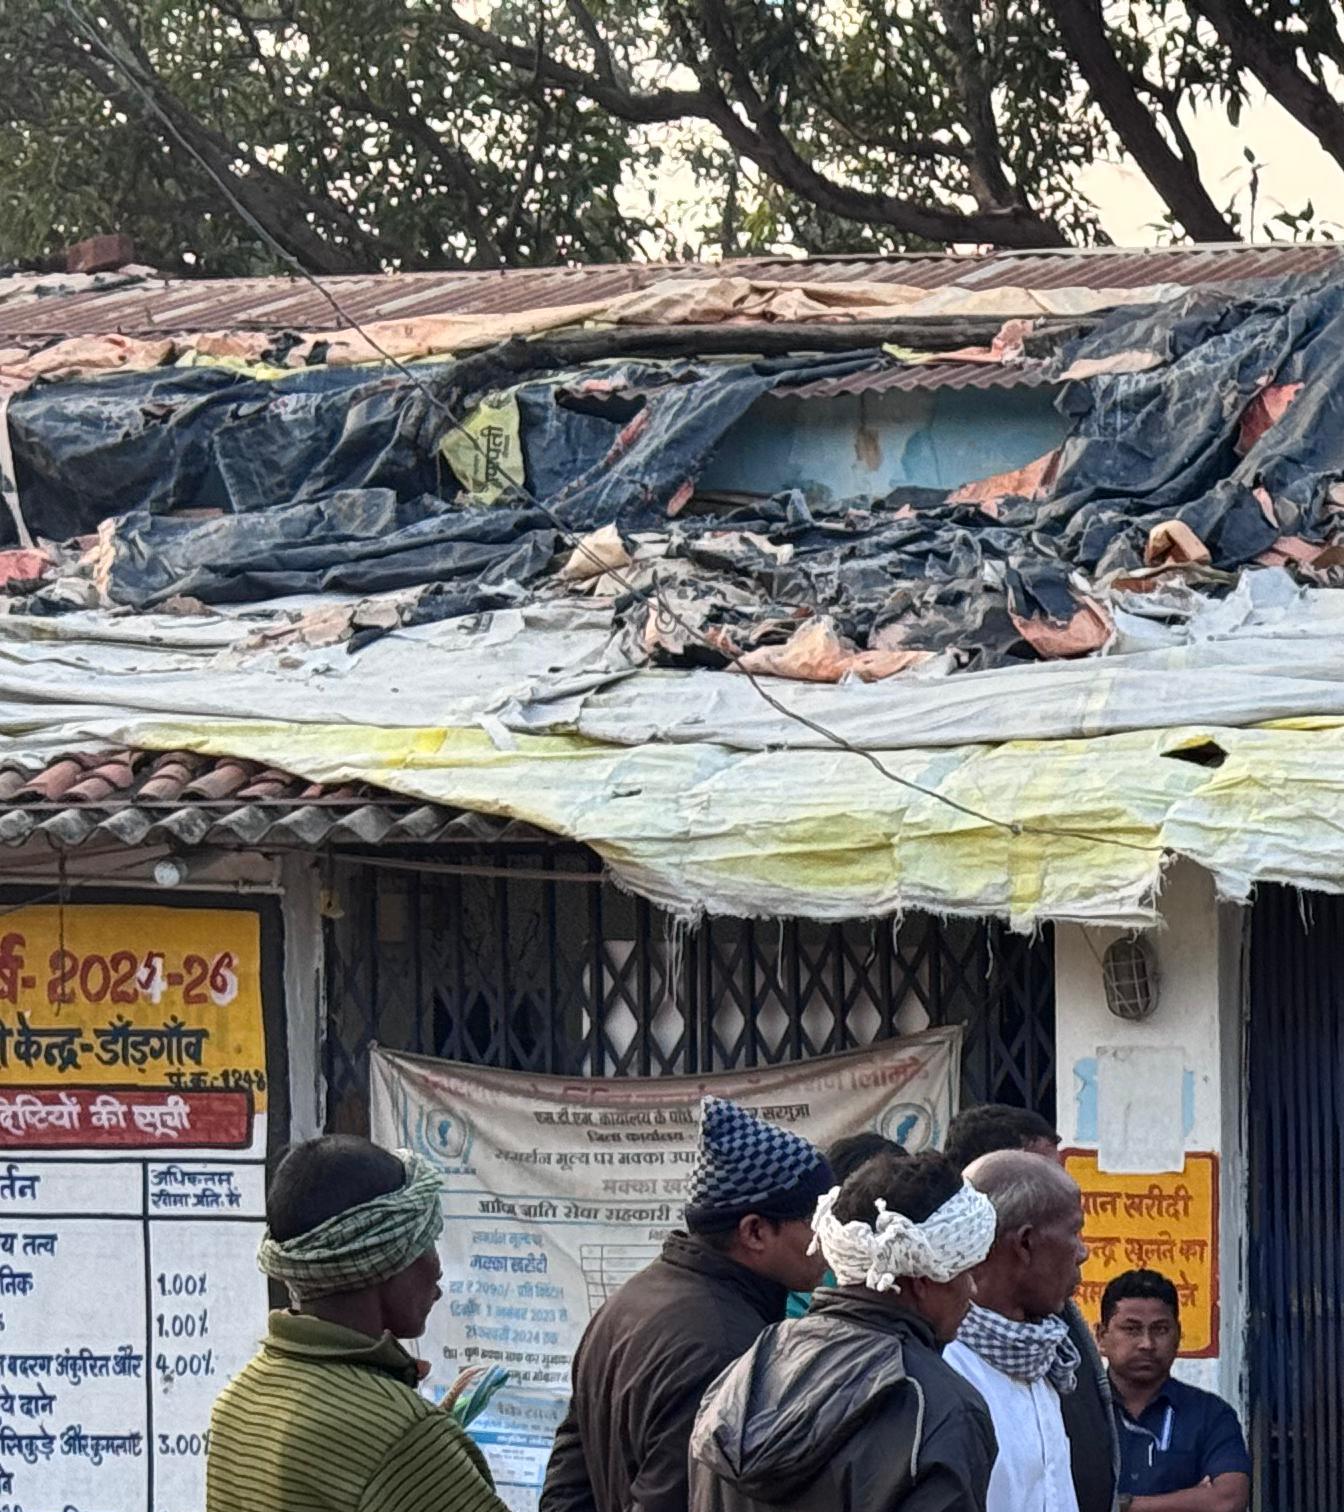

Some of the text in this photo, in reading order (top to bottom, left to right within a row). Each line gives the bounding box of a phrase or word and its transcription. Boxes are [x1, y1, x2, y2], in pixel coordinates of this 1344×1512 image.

[90, 1094, 191, 1138] की सूची
[556, 1152, 589, 1171] मूल्य
[594, 1153, 614, 1166] पर
[521, 1200, 557, 1219] जाति
[563, 1201, 600, 1221] सेवा
[1081, 1185, 1192, 1221] ान खरीदी
[23, 1233, 58, 1256] तत्व
[1180, 1237, 1207, 1264] का
[157, 1271, 207, 1296] 1.00%
[157, 1309, 207, 1337] 1.00%
[56, 1348, 111, 1385] अंकुरित
[113, 1345, 143, 1377] और
[19, 1382, 56, 1418] दाने
[60, 1425, 91, 1456] और
